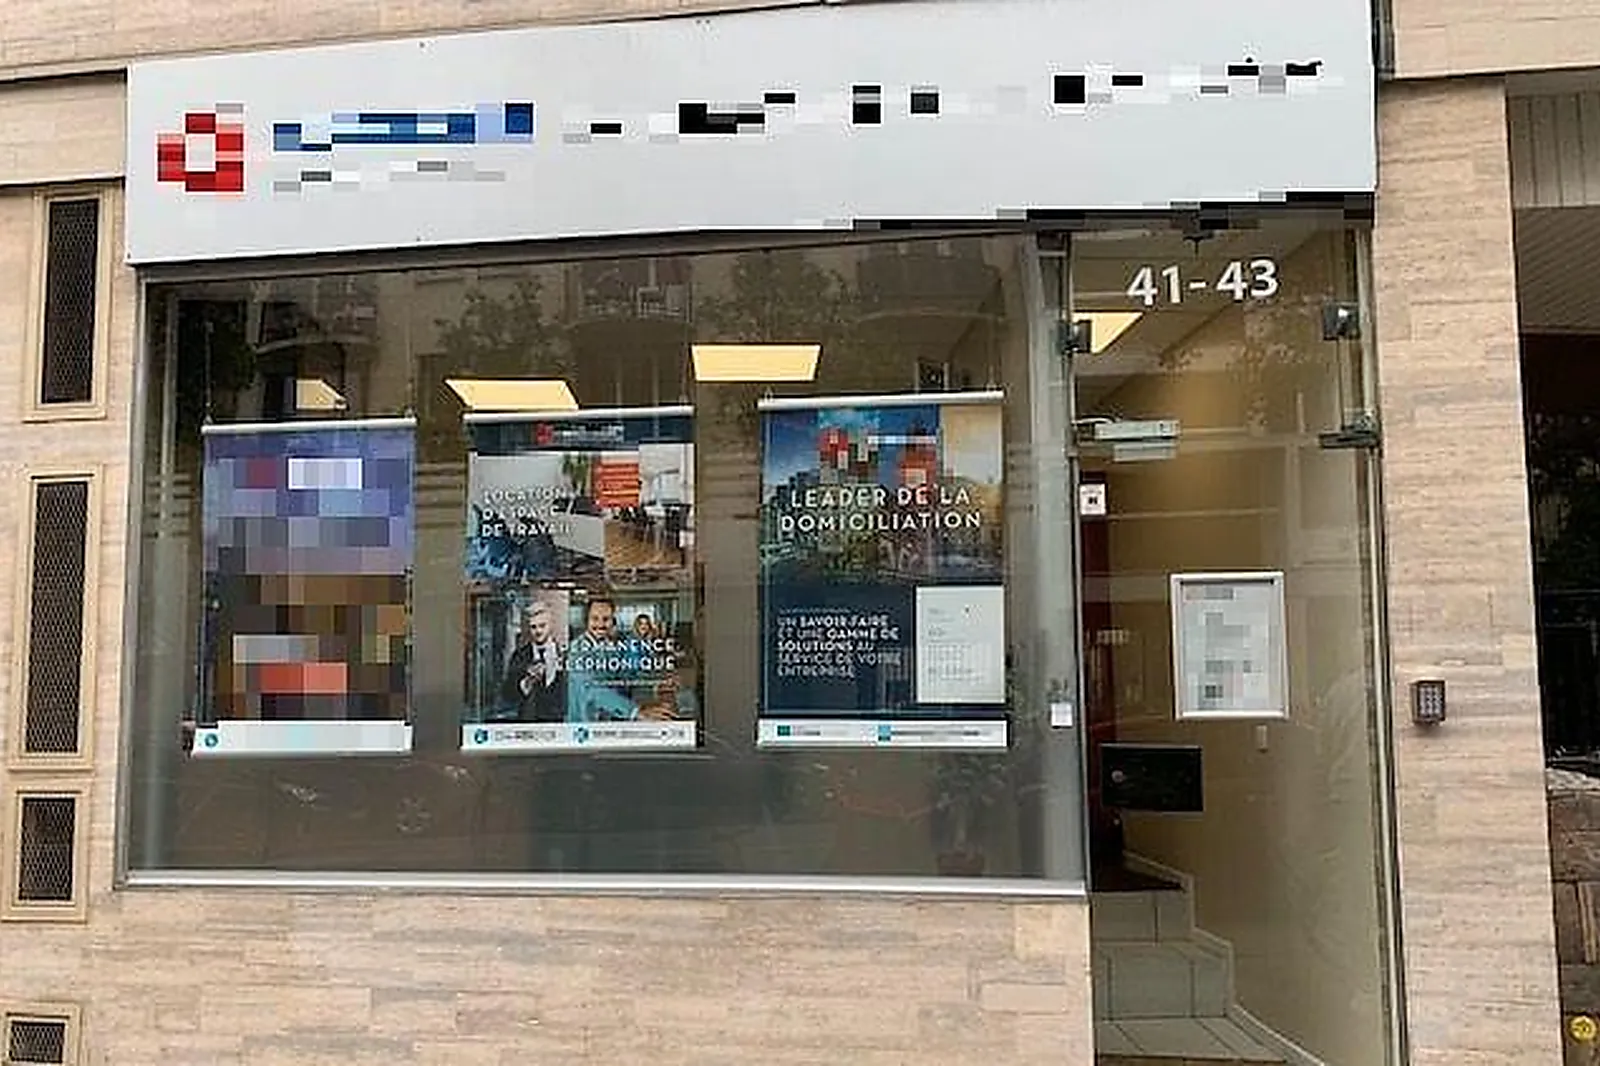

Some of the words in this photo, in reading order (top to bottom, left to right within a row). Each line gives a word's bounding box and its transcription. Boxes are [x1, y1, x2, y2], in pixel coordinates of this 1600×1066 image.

[1127, 259, 1278, 306] 41-43
[791, 487, 886, 508] LEADER
[897, 487, 929, 506] DE
[940, 486, 970, 505] LA
[781, 511, 981, 531] DOMICILIATION
[826, 627, 877, 640] GAMME
[778, 640, 854, 652] SOLUTIONS
